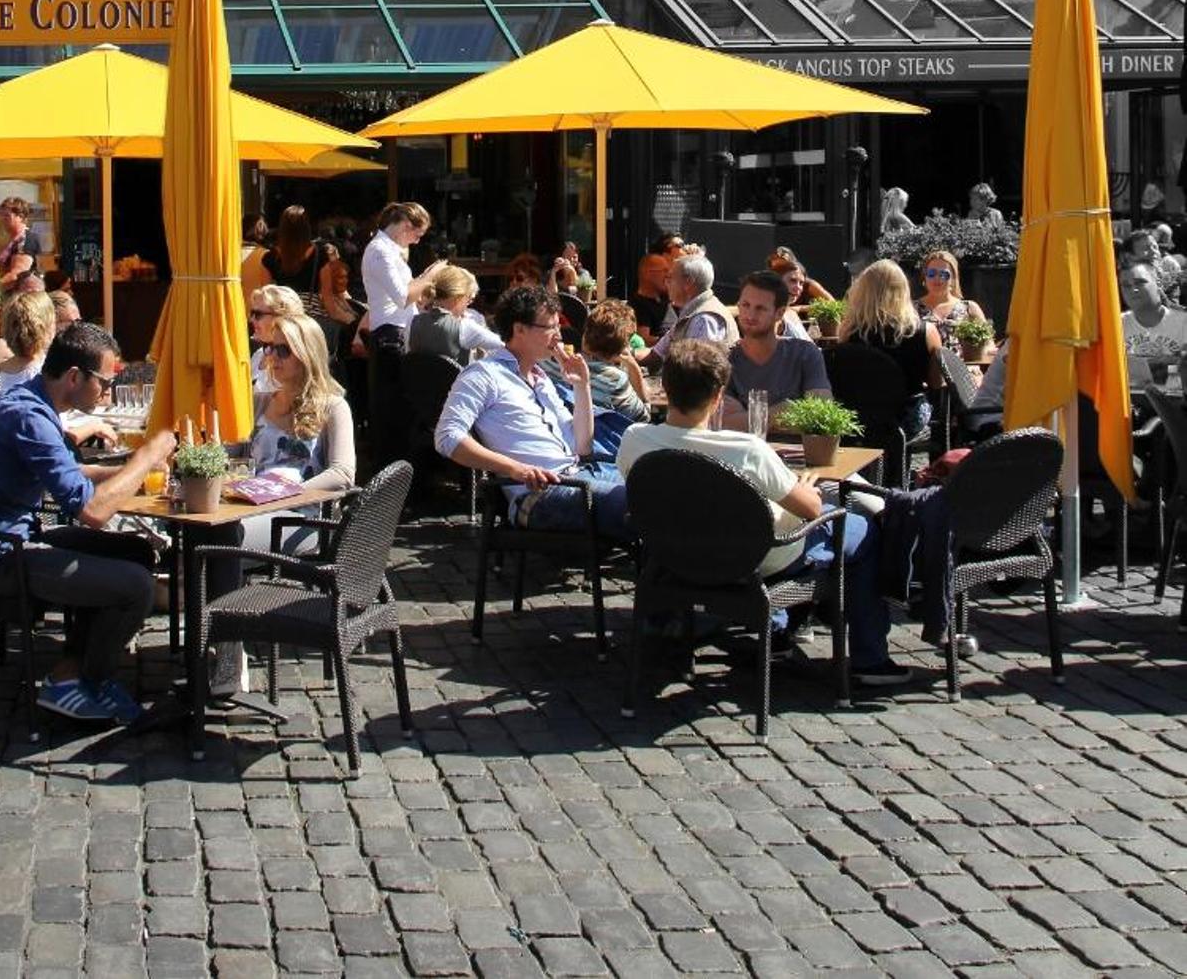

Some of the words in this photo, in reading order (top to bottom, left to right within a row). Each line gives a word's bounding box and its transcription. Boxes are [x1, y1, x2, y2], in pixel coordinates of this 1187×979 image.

[795, 58, 853, 76] ANGUS
[857, 58, 891, 76] TOP
[898, 57, 955, 76] STEAKS
[1121, 55, 1174, 73] DINER
